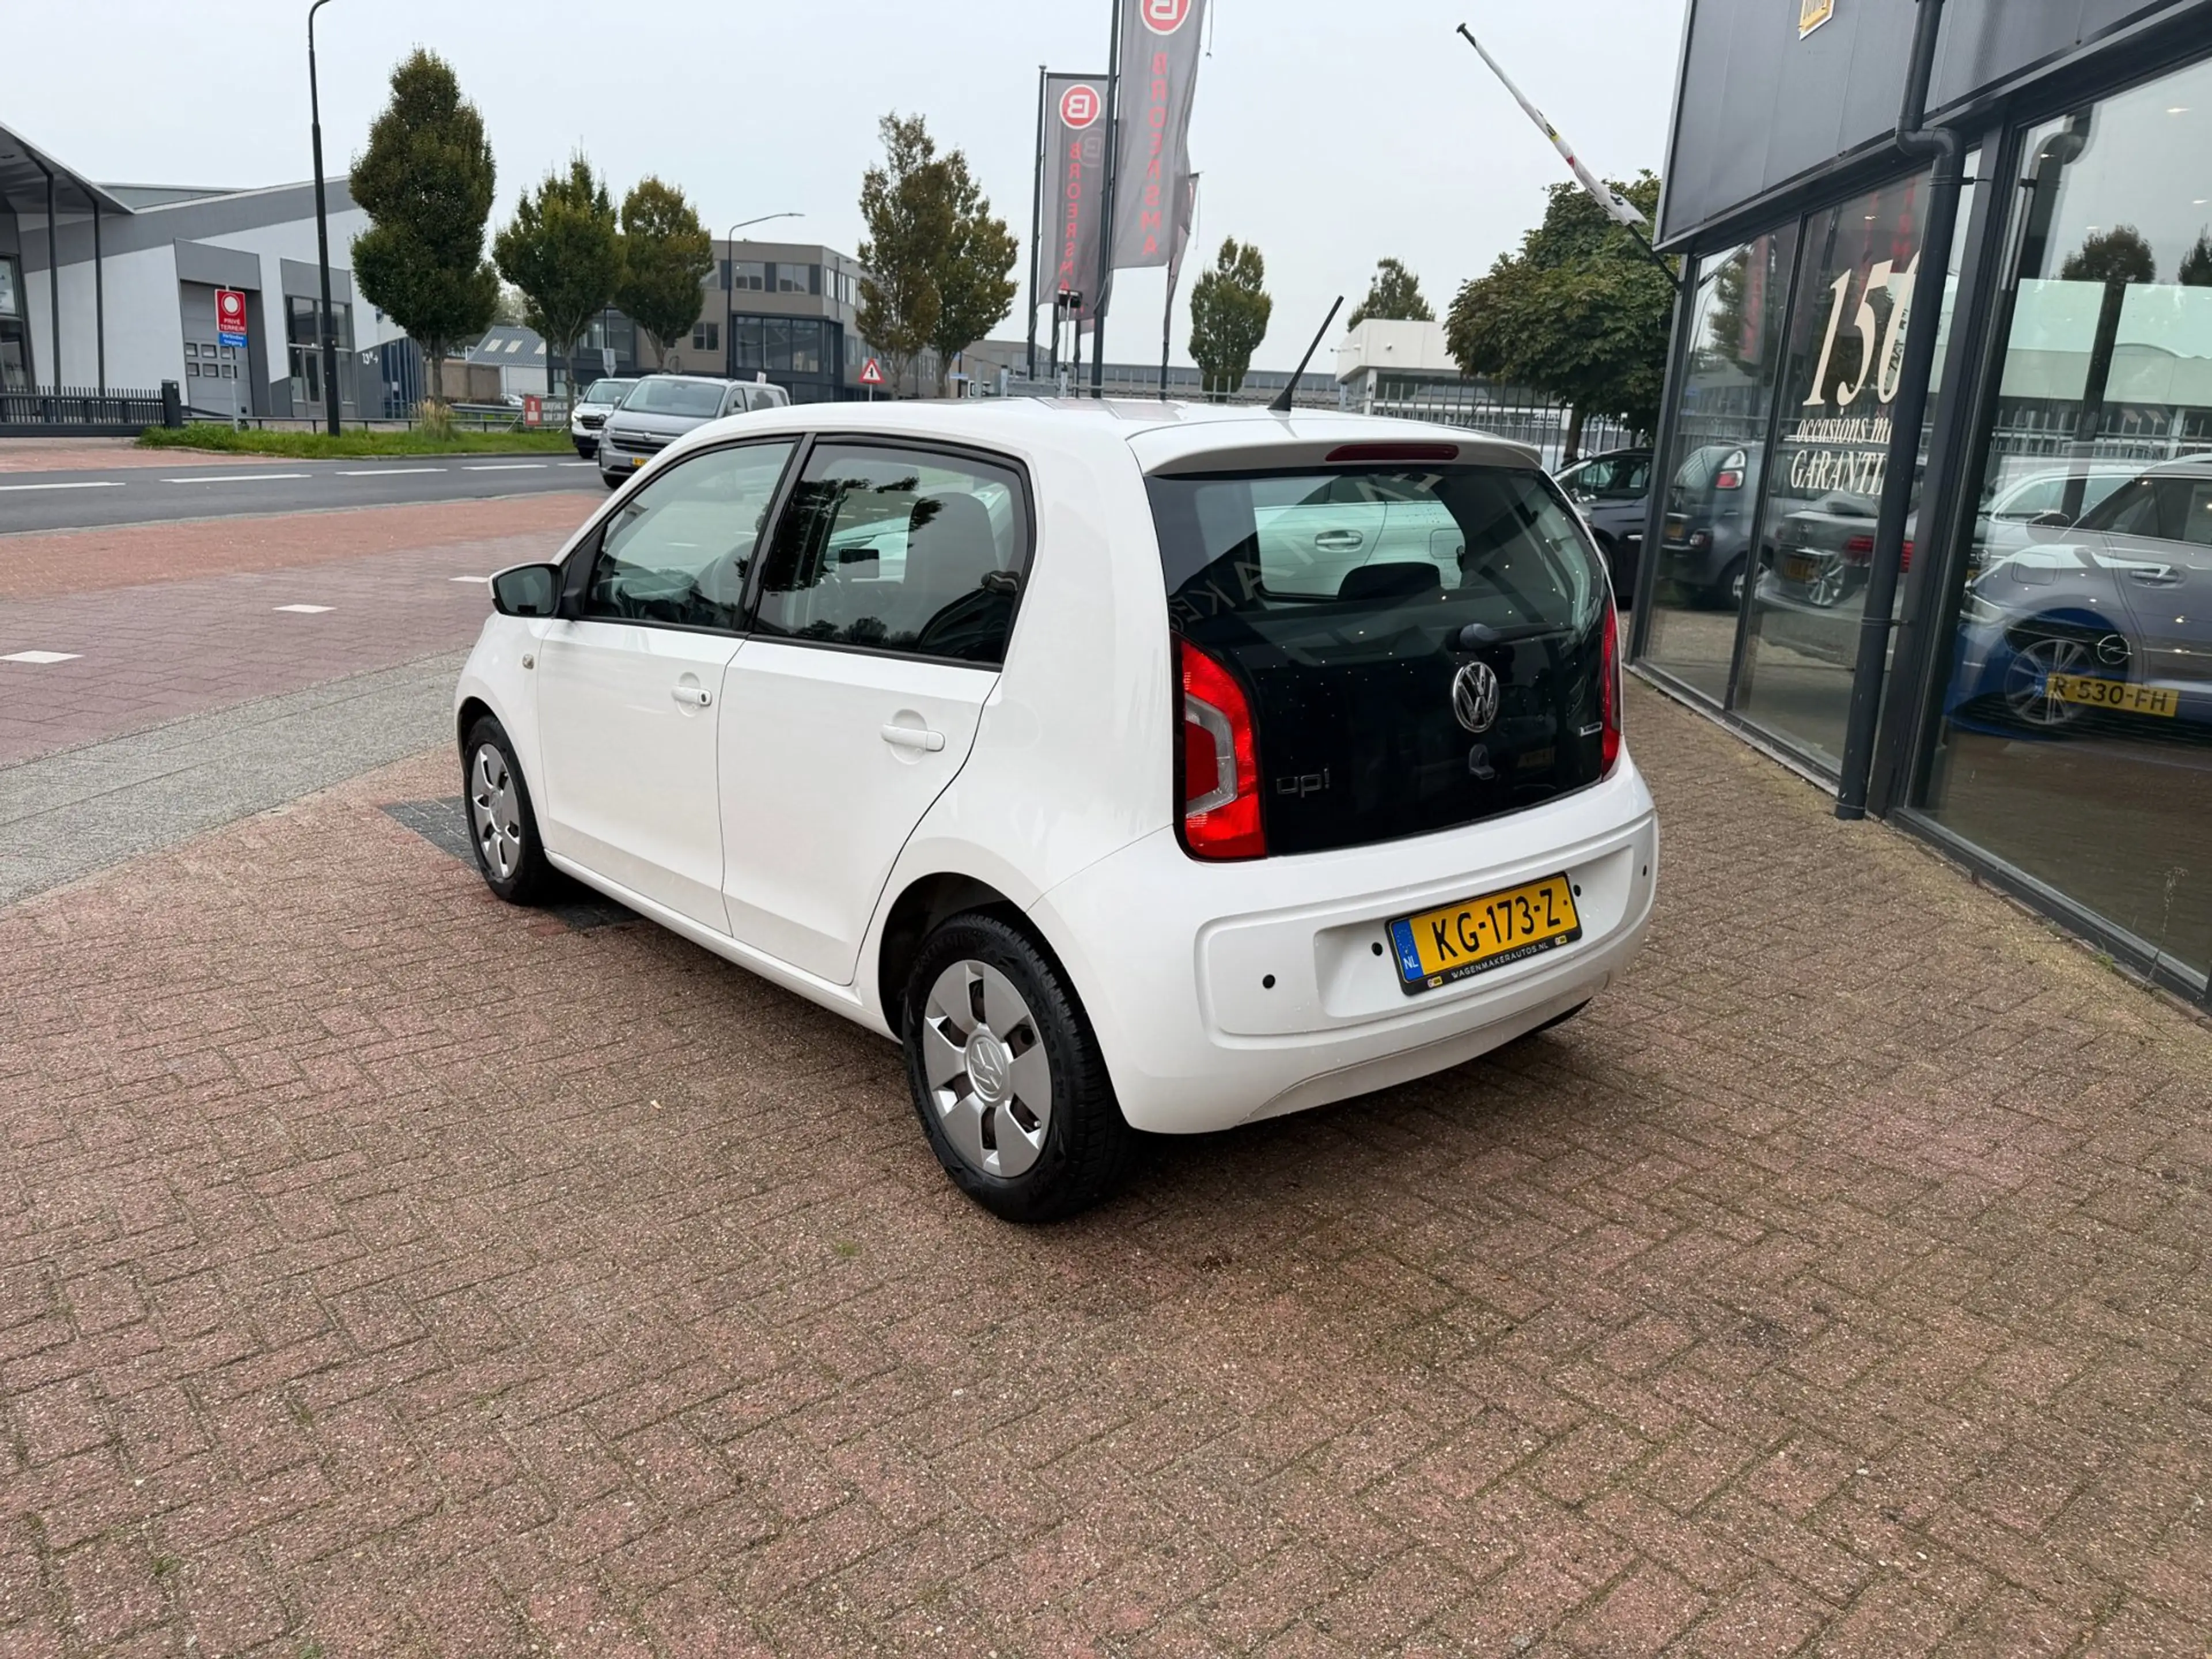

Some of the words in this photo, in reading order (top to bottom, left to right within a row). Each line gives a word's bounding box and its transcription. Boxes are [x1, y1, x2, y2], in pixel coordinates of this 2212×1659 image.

[1797, 408, 1869, 444] occasions
[1870, 417, 1893, 445] m
[1790, 449, 1887, 495] GARANTI
[1431, 888, 1560, 961] KG-173-Z
[1403, 955, 1419, 970] NL
[1450, 942, 1549, 979] WAGENMAKERAUTOS.NL
